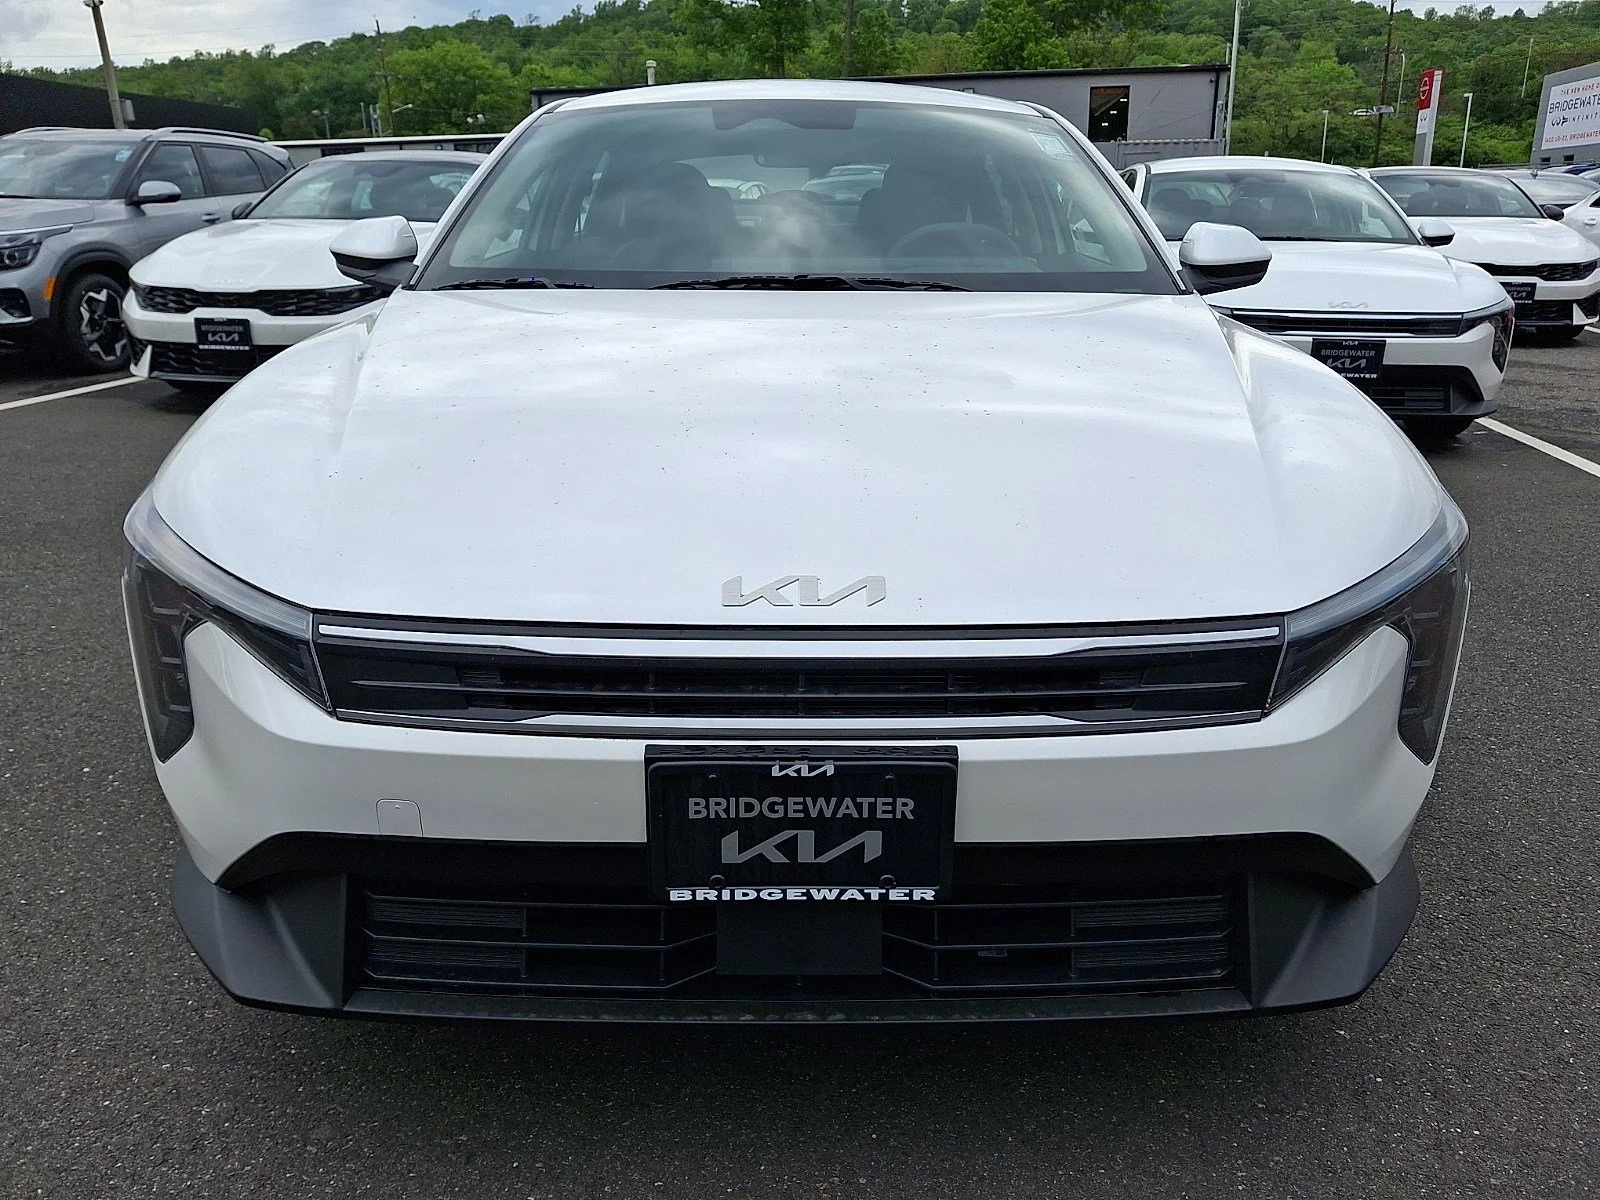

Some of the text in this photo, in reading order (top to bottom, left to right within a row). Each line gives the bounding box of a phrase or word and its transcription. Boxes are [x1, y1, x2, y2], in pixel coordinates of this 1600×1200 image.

[1568, 112, 1600, 123] INFINIT
[1320, 349, 1376, 357] BRIDGEWATER
[721, 575, 886, 607] KIA
[771, 760, 835, 777] KIA
[688, 797, 915, 820] BRIDGEWATER
[721, 829, 883, 864] KIA
[669, 888, 936, 901] BRIDGEWATER
